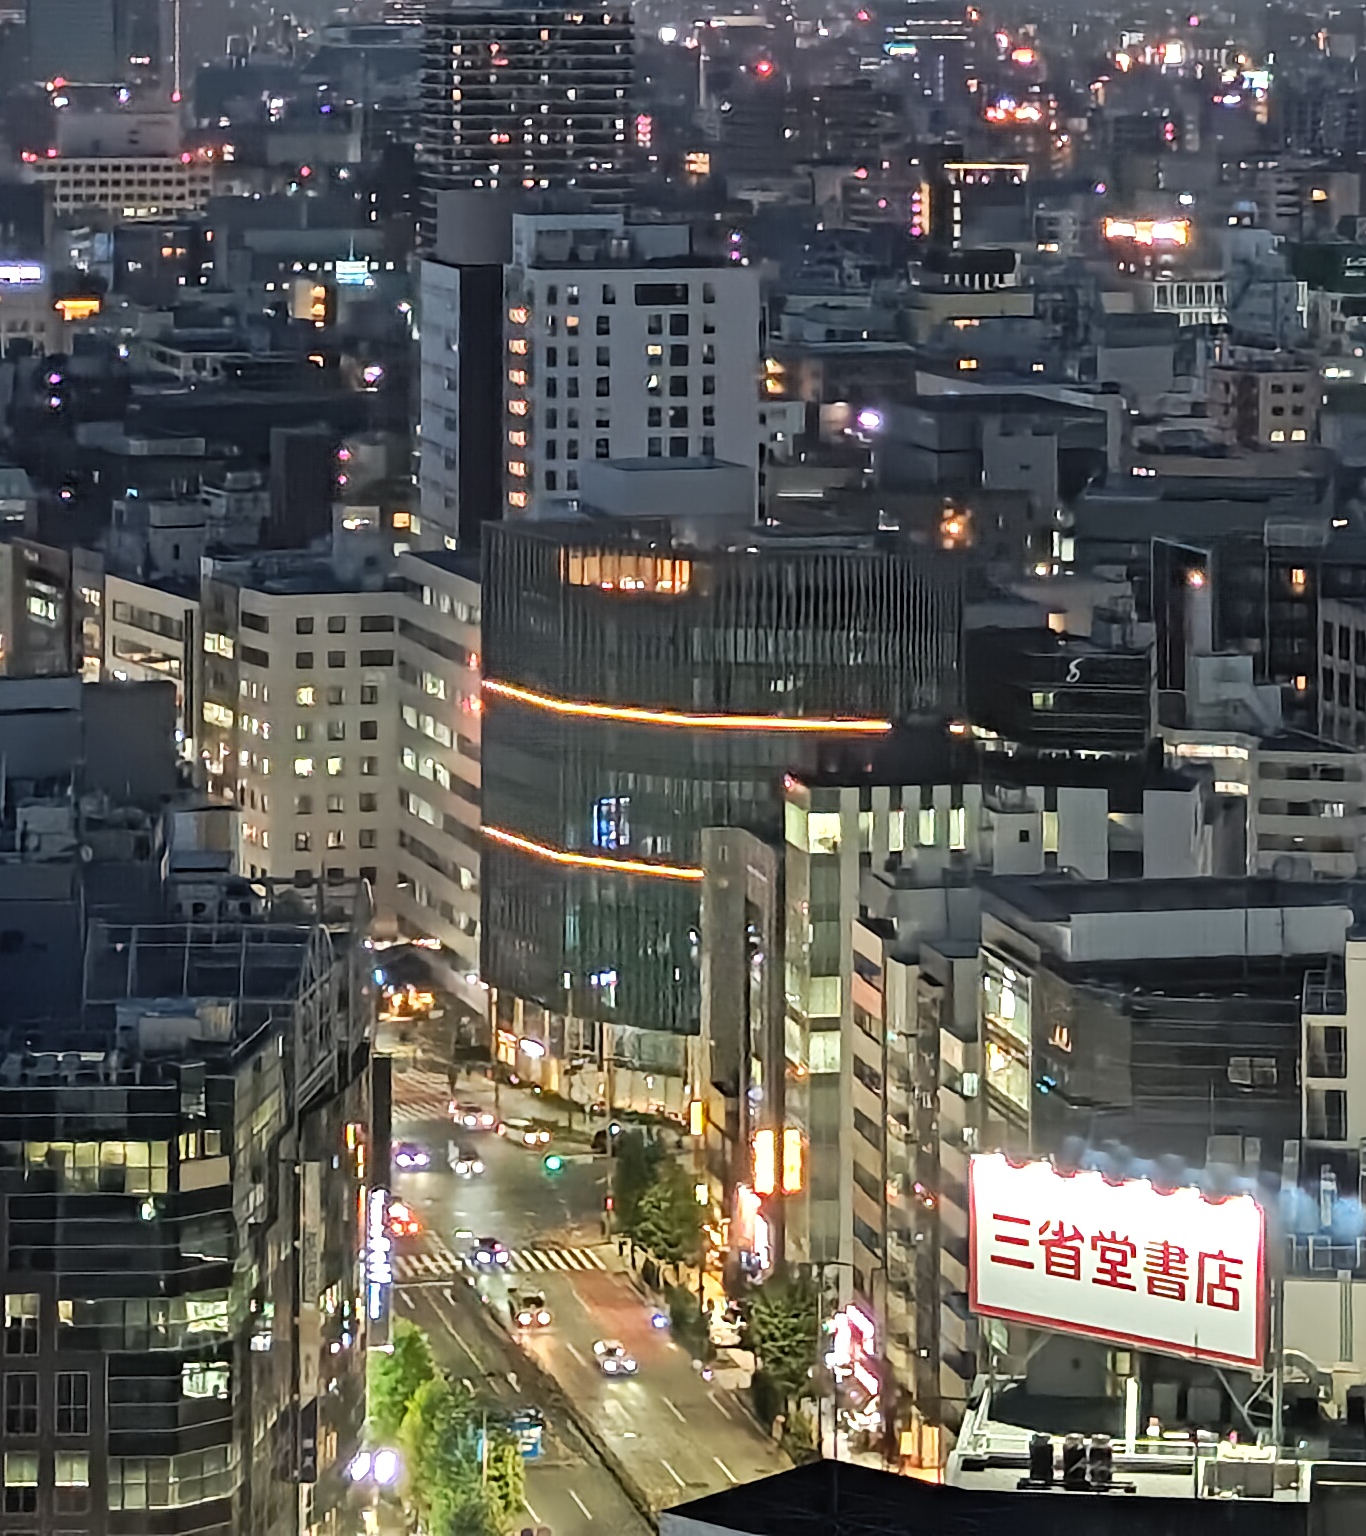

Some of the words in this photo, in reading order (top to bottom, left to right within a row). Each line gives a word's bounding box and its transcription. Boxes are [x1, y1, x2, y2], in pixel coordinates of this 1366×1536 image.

[990, 1213, 1244, 1312] 三省堂書店
